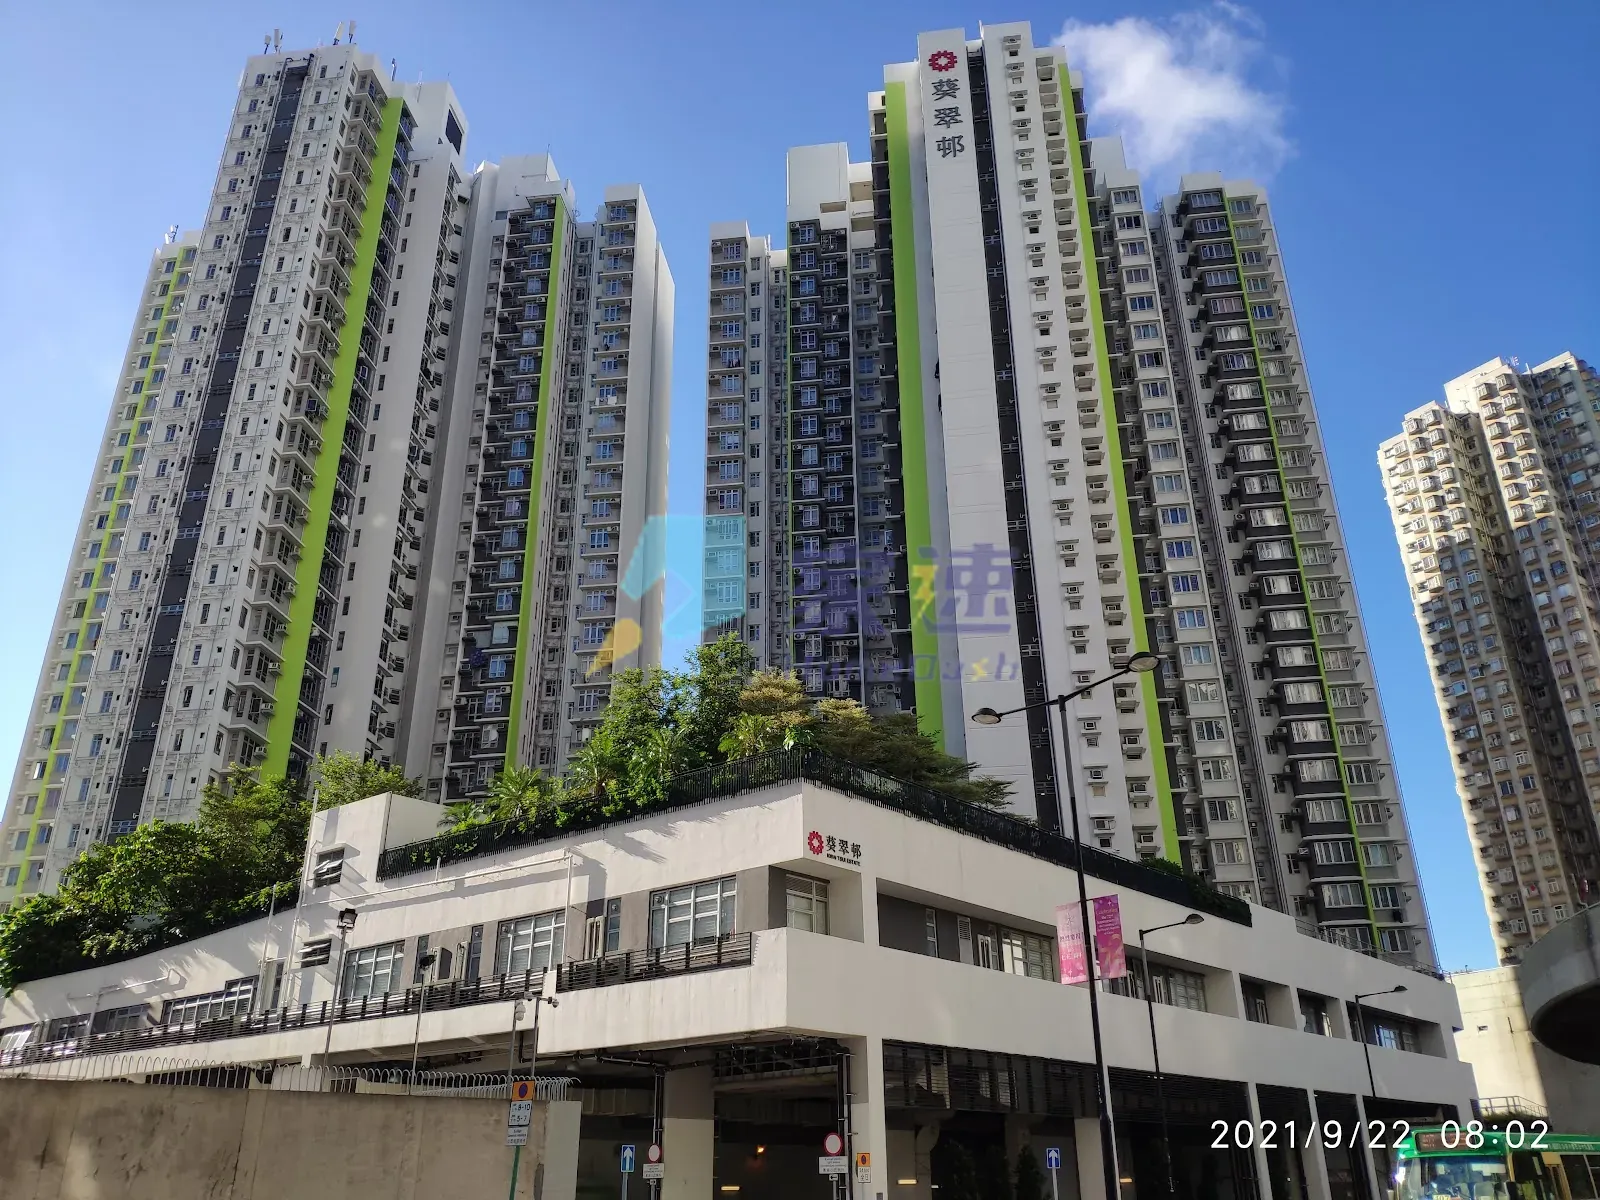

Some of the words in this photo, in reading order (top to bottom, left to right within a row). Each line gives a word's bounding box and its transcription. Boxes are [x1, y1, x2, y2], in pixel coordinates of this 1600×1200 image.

[931, 78, 965, 159] 葵翠邨
[826, 834, 862, 860] 葵翠邨
[847, 858, 861, 867] ESTATE
[517, 1103, 531, 1111] 8-10
